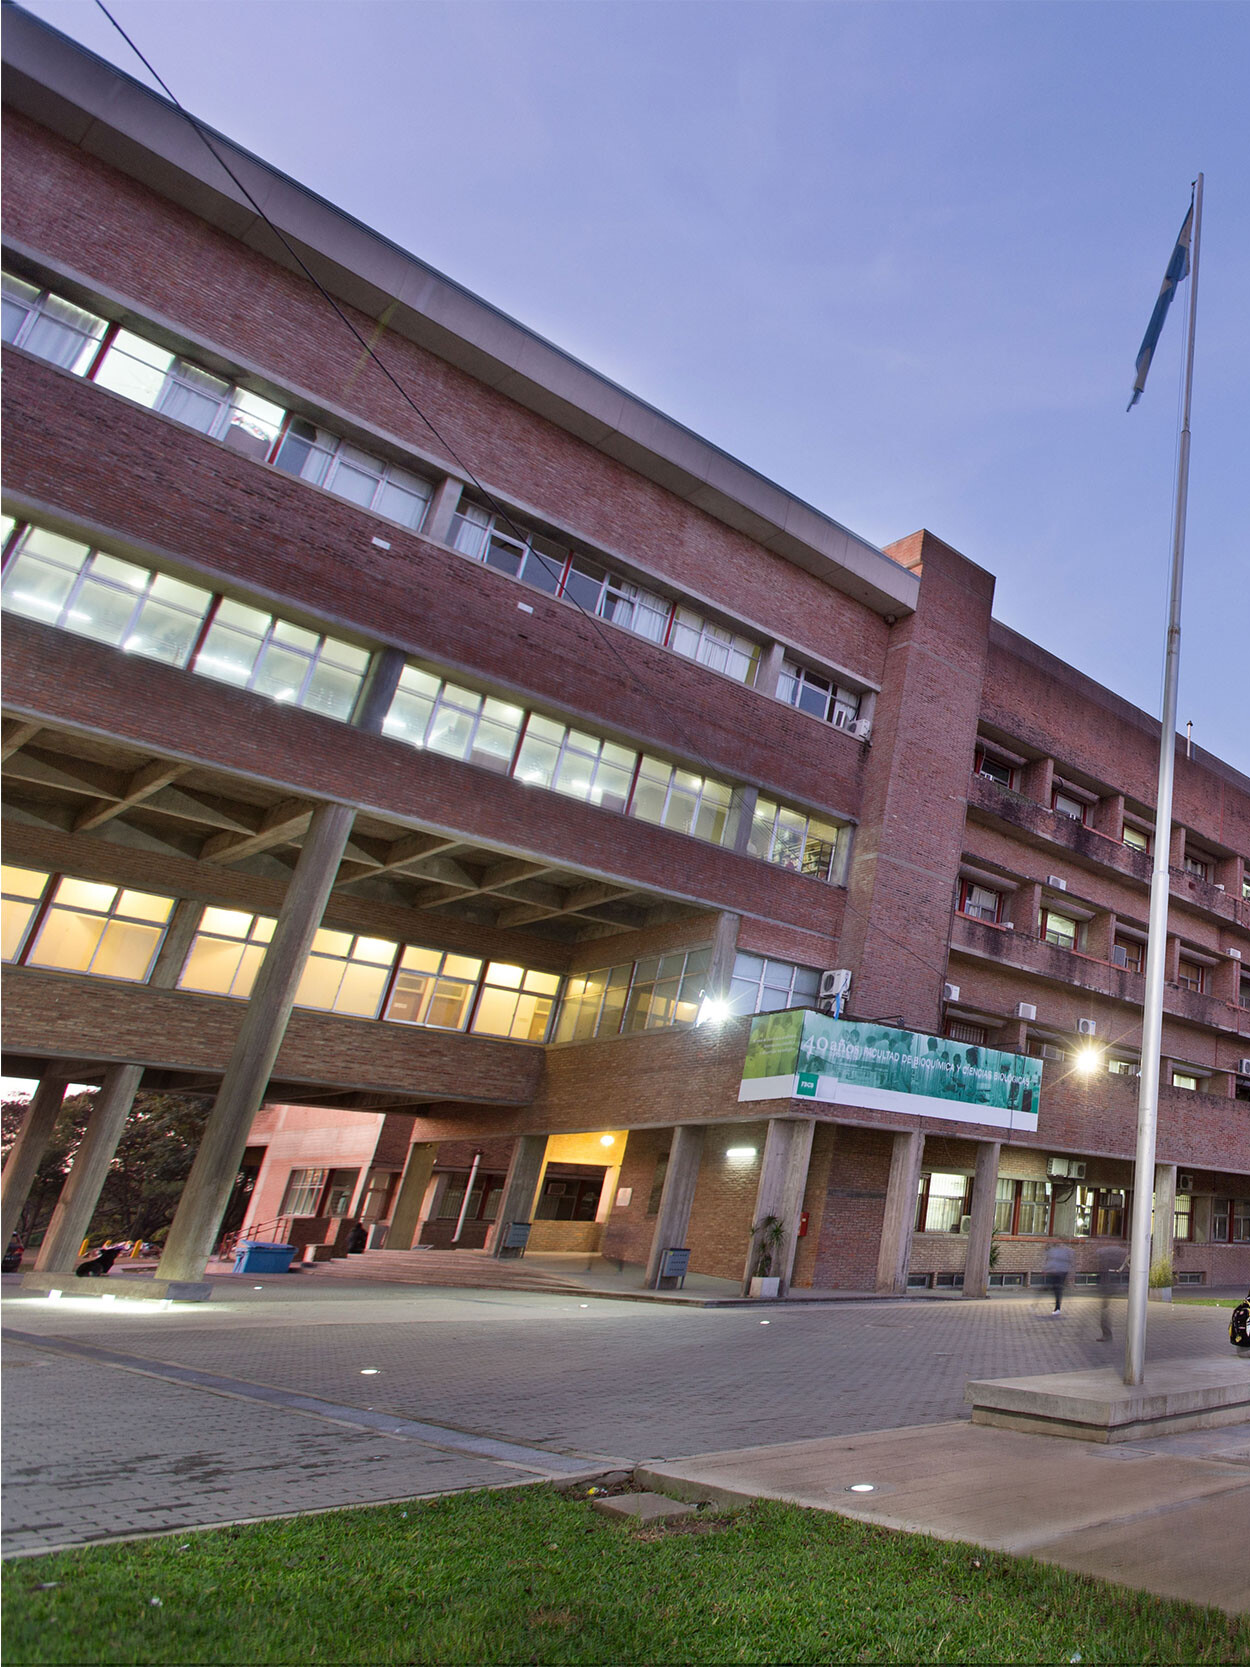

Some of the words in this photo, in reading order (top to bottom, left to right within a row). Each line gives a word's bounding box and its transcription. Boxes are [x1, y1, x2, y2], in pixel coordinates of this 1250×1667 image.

[801, 1034, 829, 1060] 40
[830, 1038, 859, 1056] años
[863, 1046, 900, 1062] FACULTAD
[901, 1053, 912, 1064] DE
[913, 1056, 954, 1073] BIOQUÍMICA
[962, 1066, 993, 1081] CIENCIAS
